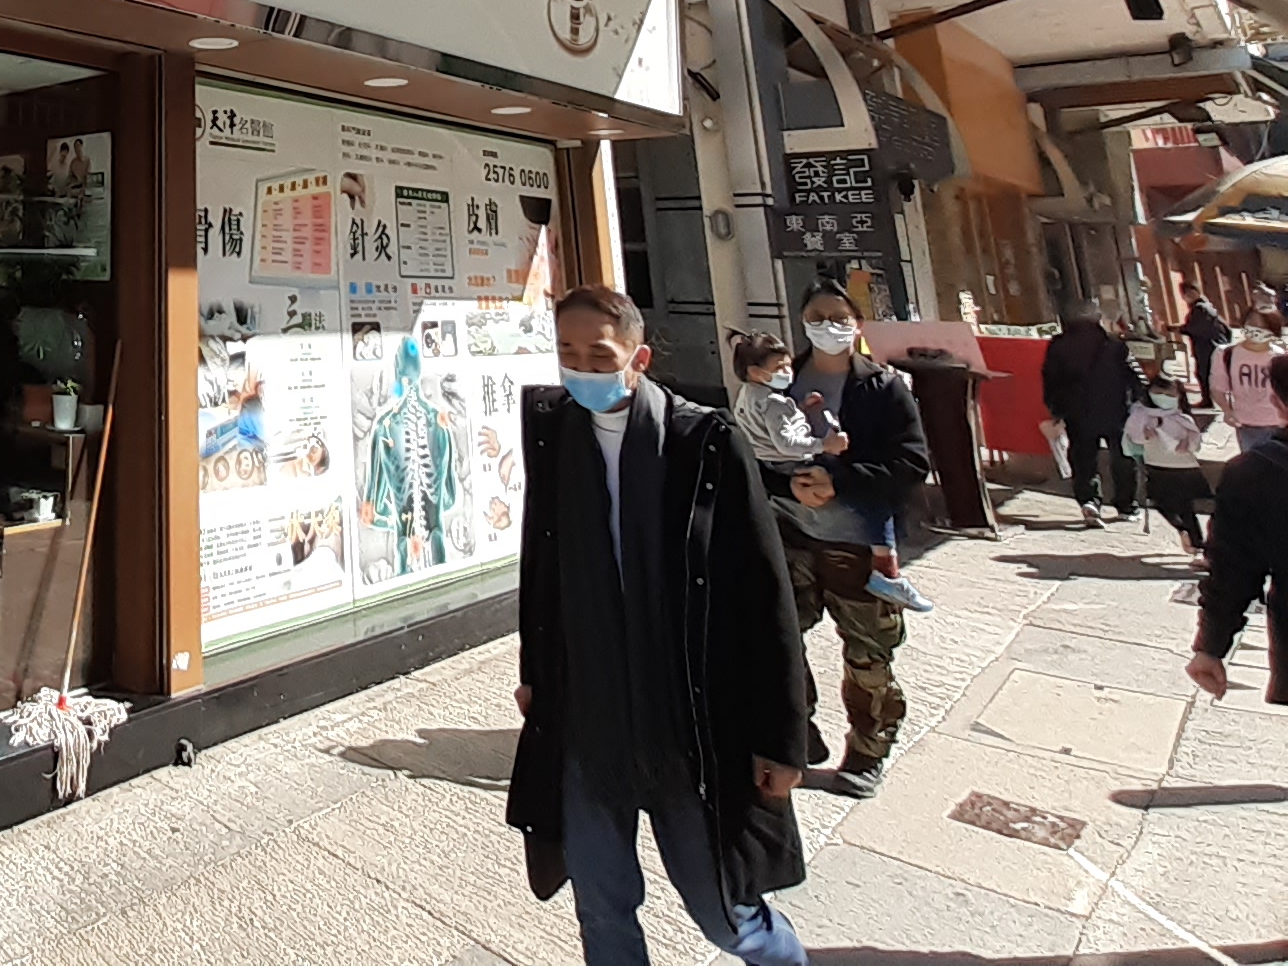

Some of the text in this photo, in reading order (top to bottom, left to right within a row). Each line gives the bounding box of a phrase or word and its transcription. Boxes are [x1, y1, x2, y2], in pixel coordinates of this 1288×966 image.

[483, 162, 549, 189] 2576 0600
[790, 155, 872, 190] 發記
[795, 189, 875, 204] FAT KEE
[784, 213, 874, 231] 東南亞
[349, 217, 392, 261] 針灸
